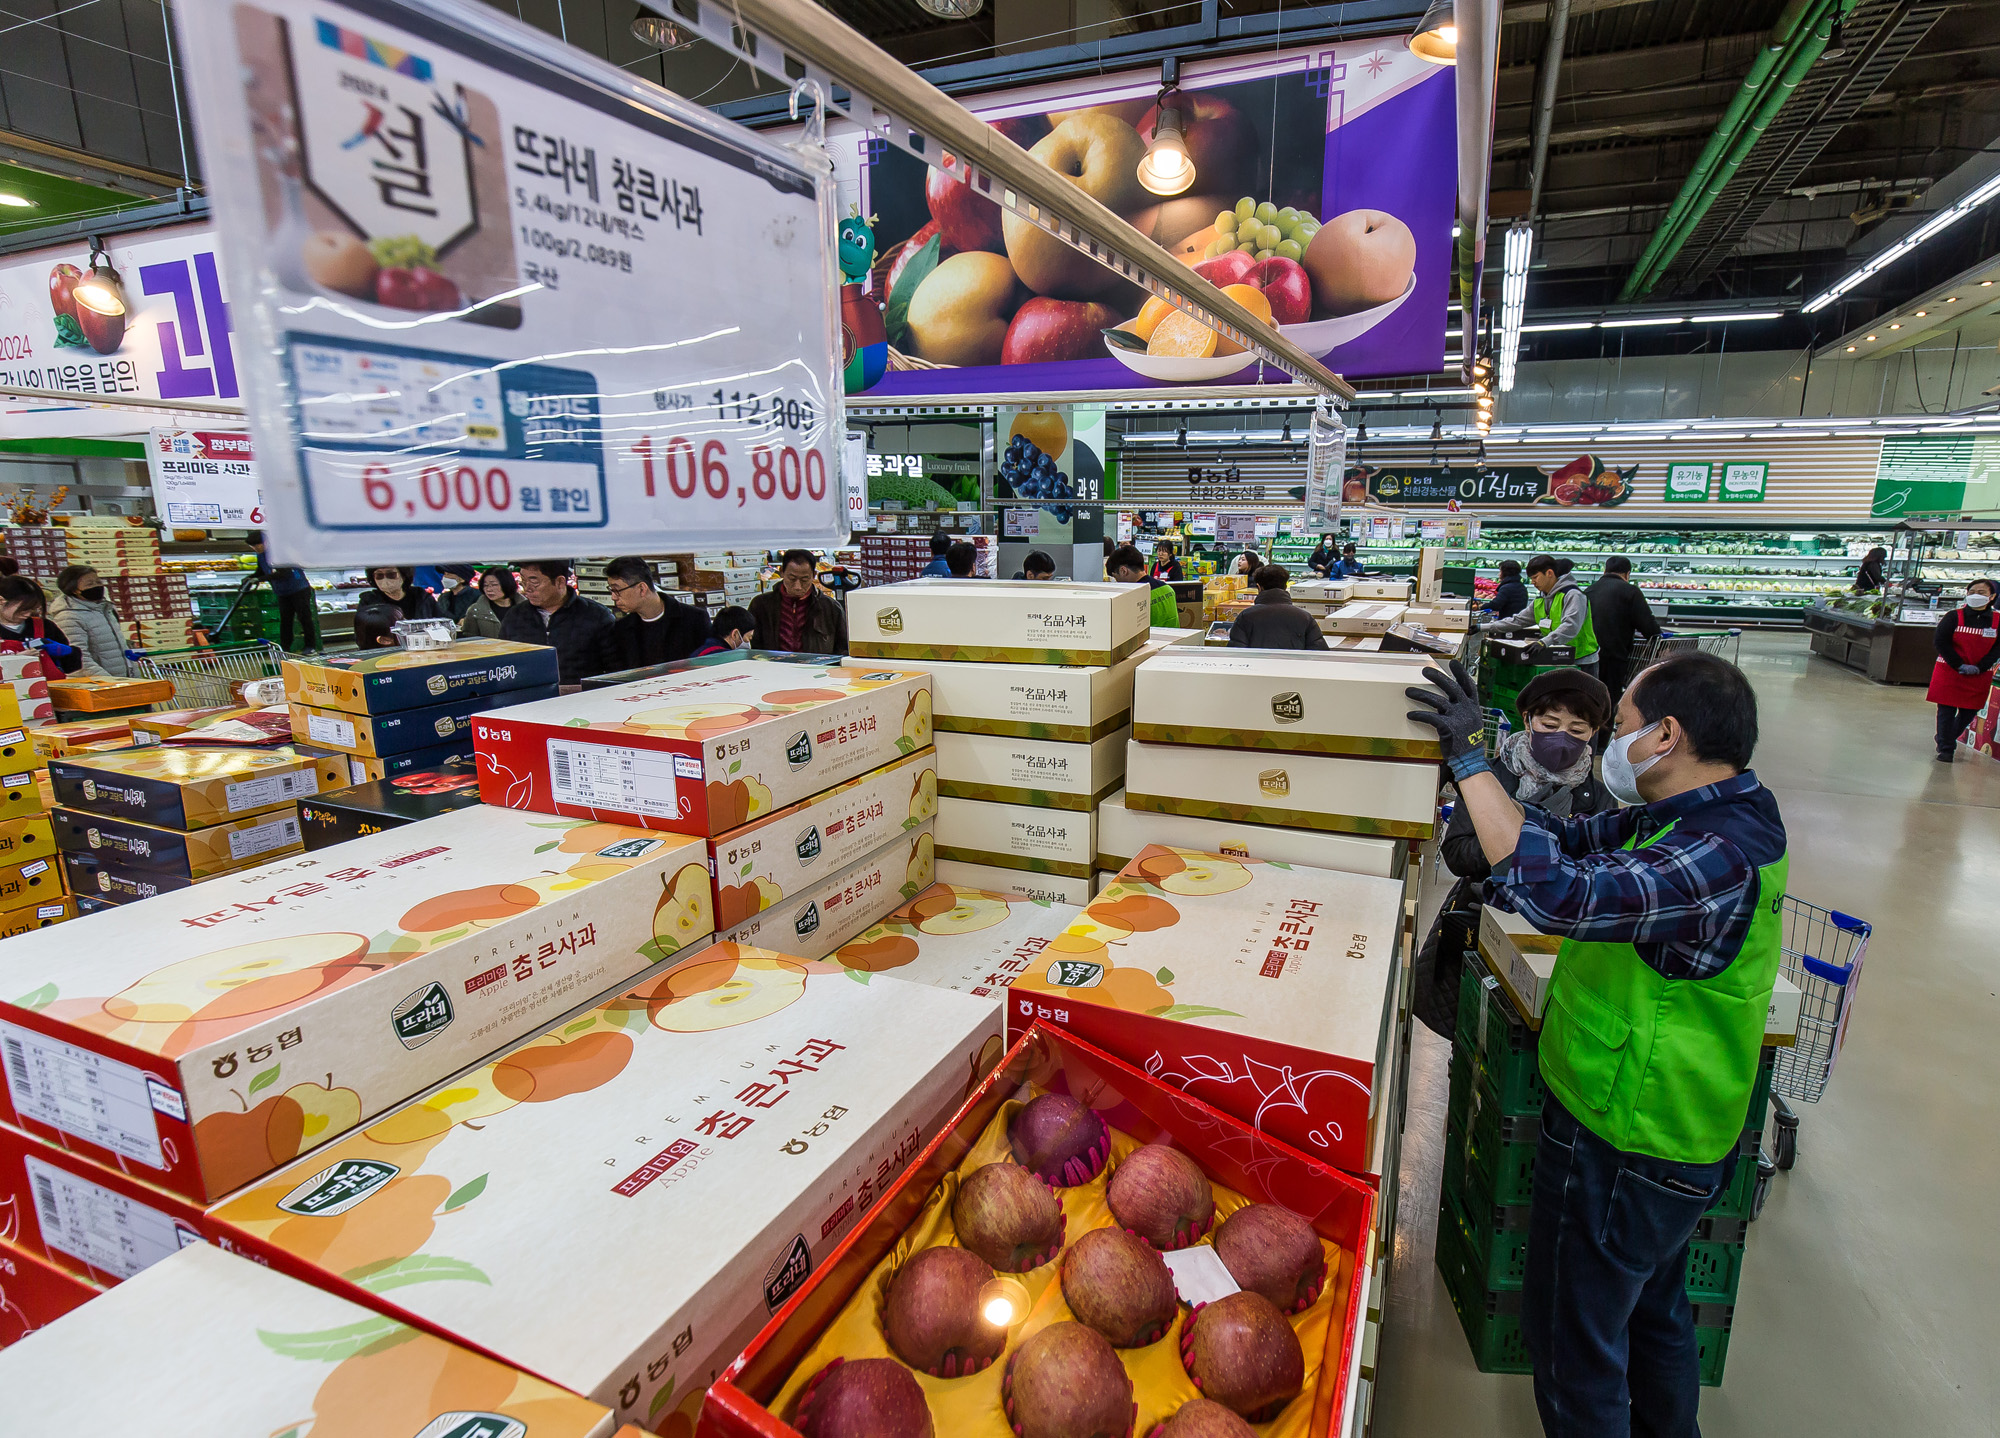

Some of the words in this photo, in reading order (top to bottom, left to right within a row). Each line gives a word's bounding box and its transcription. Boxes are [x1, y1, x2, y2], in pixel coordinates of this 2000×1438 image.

[514, 125, 599, 203] 뜨라네
[611, 157, 703, 236] 참큰사과
[522, 261, 559, 290] 국산
[162, 461, 219, 475] 프리미엄
[631, 434, 826, 508] 106,800
[926, 462, 953, 473] Luxury
[954, 463, 971, 472] fruit
[1676, 470, 1704, 481] 유기농
[1731, 470, 1759, 481] 무농약
[362, 462, 512, 518] 6,000
[519, 487, 543, 512] 원
[549, 487, 591, 512] 할인
[1189, 486, 1267, 501] 친환경농산물
[1403, 485, 1457, 497] 친환경농산물
[1078, 509, 1091, 520] Fruits
[880, 618, 901, 628] 뜨라네
[1042, 614, 1087, 628] 名品사과
[449, 679, 466, 688] GAP
[1025, 687, 1068, 702] 名品사과
[1275, 703, 1301, 715] 뜨라네
[490, 728, 512, 742] 농협
[728, 738, 751, 756] 농협
[1026, 755, 1068, 771] 名品사과
[1262, 778, 1287, 790] 뜨라네
[1025, 824, 1067, 840] 名品사과
[740, 838, 762, 858] 농협
[739, 921, 761, 941] 농협
[1063, 963, 1091, 985] 뜨라네
[1260, 951, 1287, 978] 프리미엄
[465, 964, 507, 993] 프리미엄
[478, 978, 509, 999] Apple
[402, 1003, 446, 1034] 뜨라네
[1036, 1004, 1069, 1024] 농협
[247, 1026, 304, 1063] 농협
[803, 1104, 849, 1138] 농협
[615, 1140, 698, 1196] 프리미엄
[660, 1146, 714, 1189] Apple
[300, 1164, 383, 1211] 뜨라네
[771, 1253, 807, 1302] 뜨라네
[647, 1324, 694, 1382] 농협
